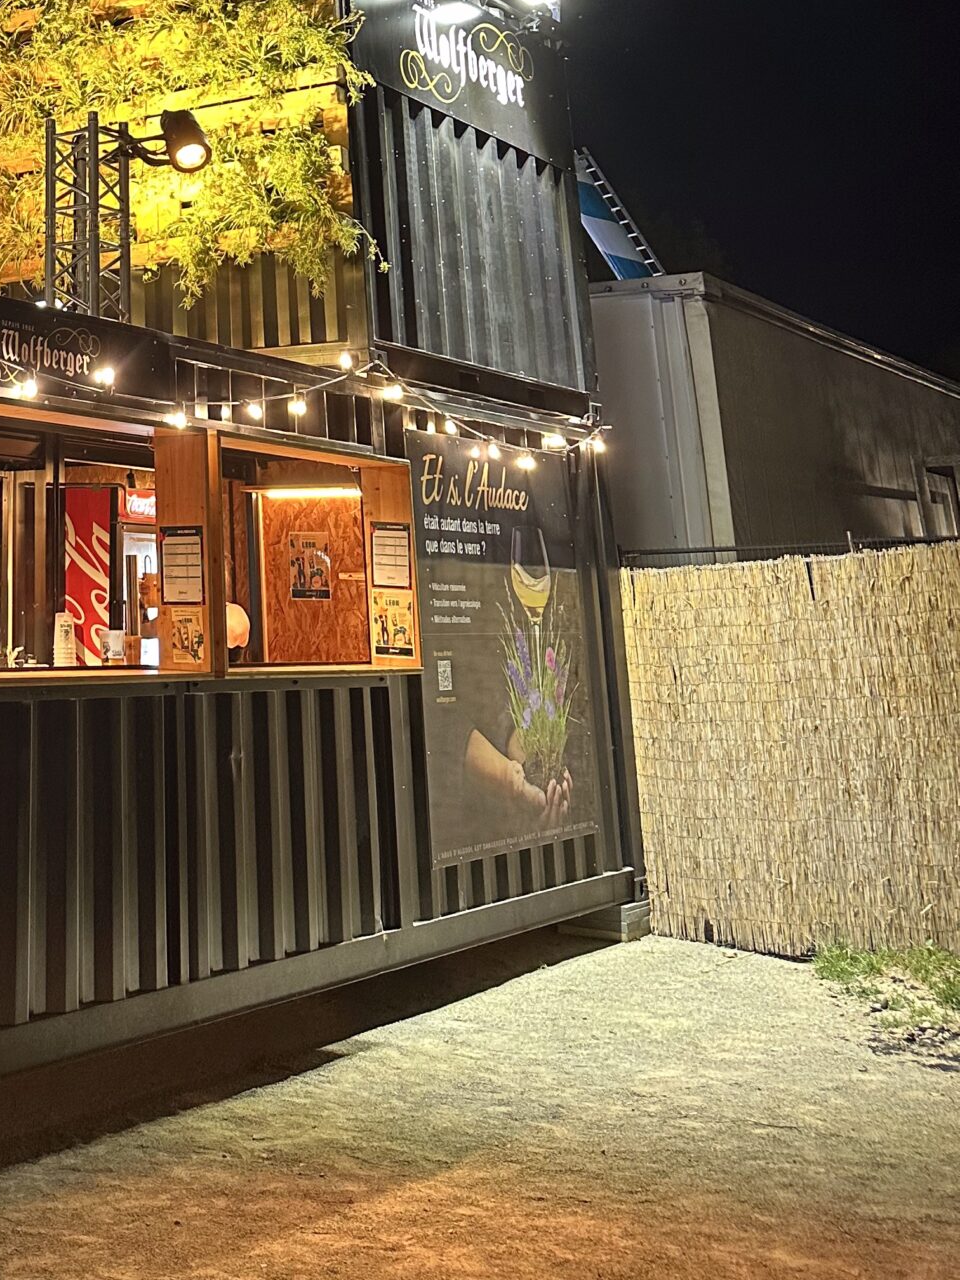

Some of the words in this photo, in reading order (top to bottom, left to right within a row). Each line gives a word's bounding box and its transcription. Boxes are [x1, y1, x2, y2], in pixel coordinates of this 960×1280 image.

[411, 4, 525, 108] Wolfberger
[1, 328, 91, 378] Wolfberger
[420, 454, 444, 505] Et
[446, 474, 462, 506] si
[423, 513, 440, 530] était
[440, 517, 461, 532] autant
[461, 517, 477, 533] dans
[478, 519, 485, 534] la
[485, 520, 501, 535] terre
[425, 540, 438, 555] que
[439, 538, 456, 554] dans
[456, 539, 464, 554] le
[464, 542, 481, 555] verre
[481, 540, 486, 556] ?
